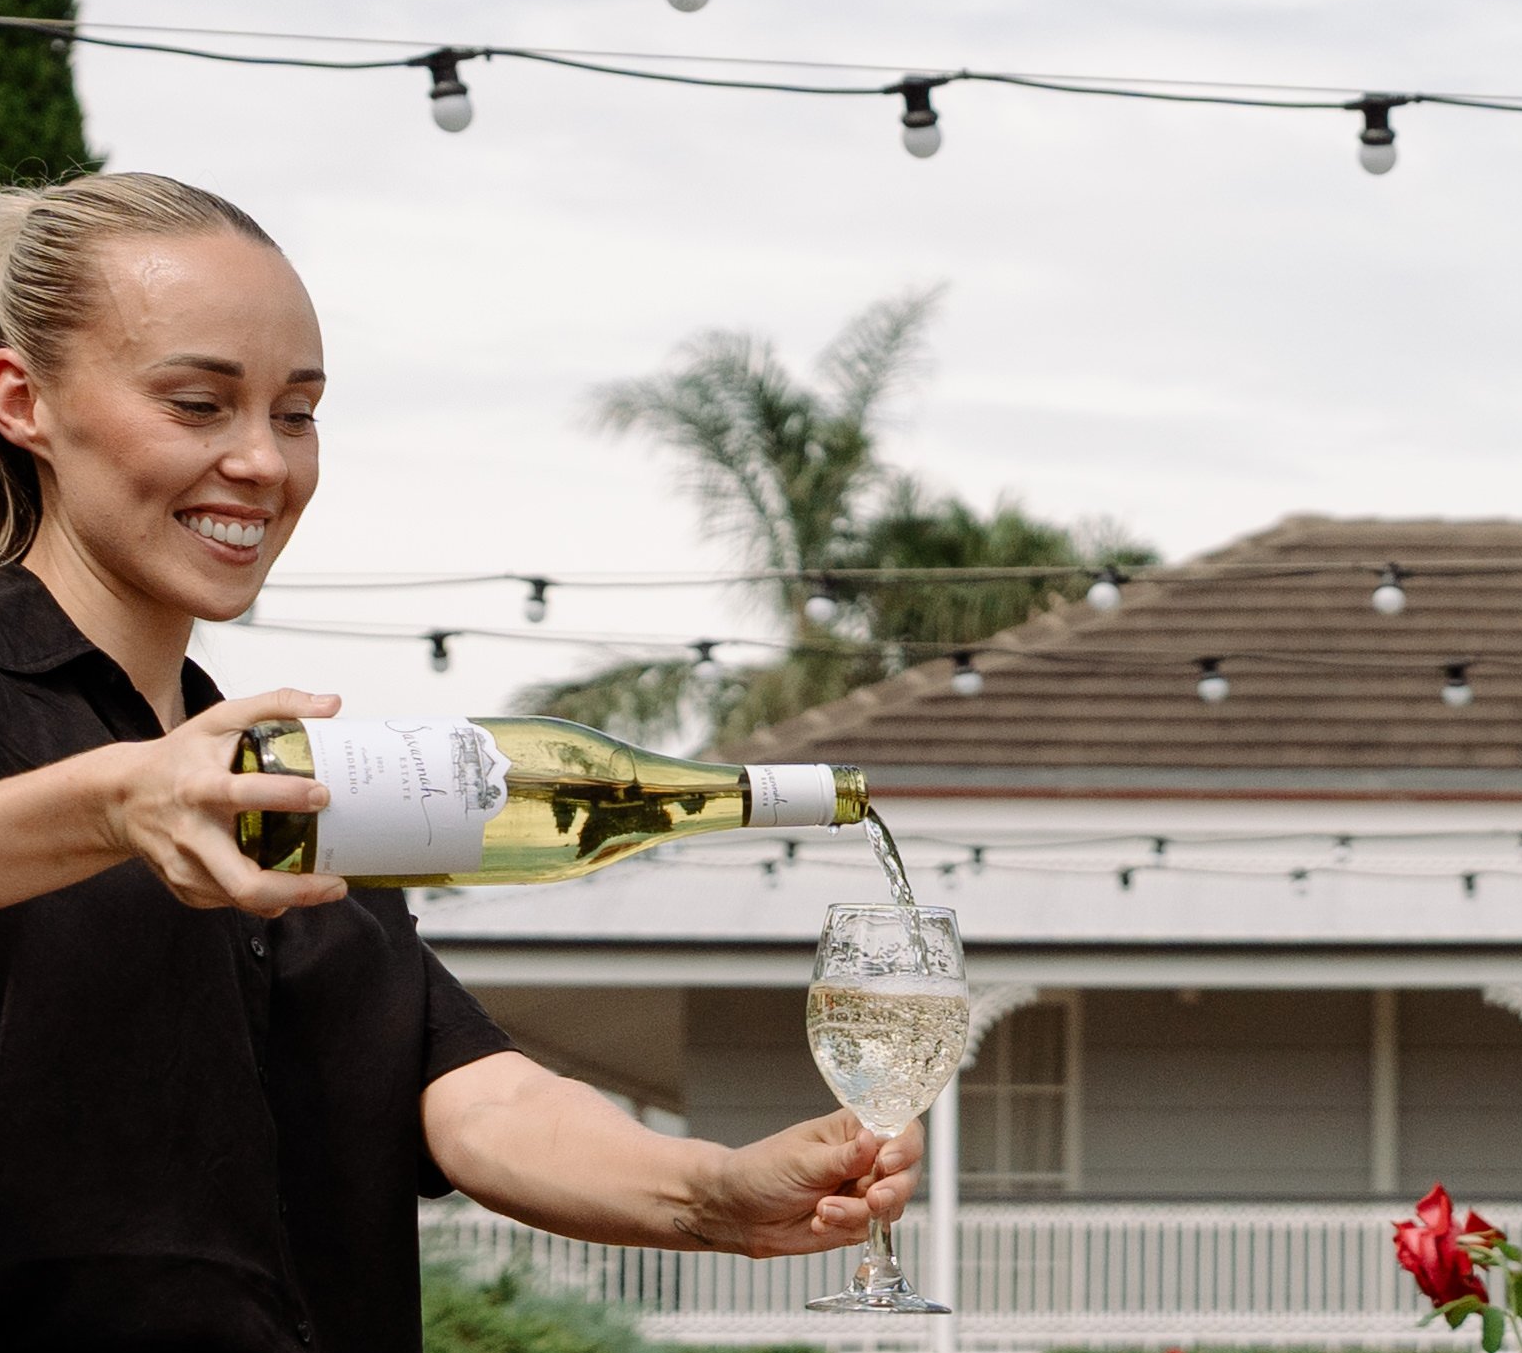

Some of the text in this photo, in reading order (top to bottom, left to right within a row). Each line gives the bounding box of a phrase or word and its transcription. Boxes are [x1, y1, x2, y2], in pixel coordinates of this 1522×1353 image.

[344, 740, 359, 795] VERDELHO
[384, 720, 448, 847] Savannah
[399, 757, 412, 801] ESTATE
